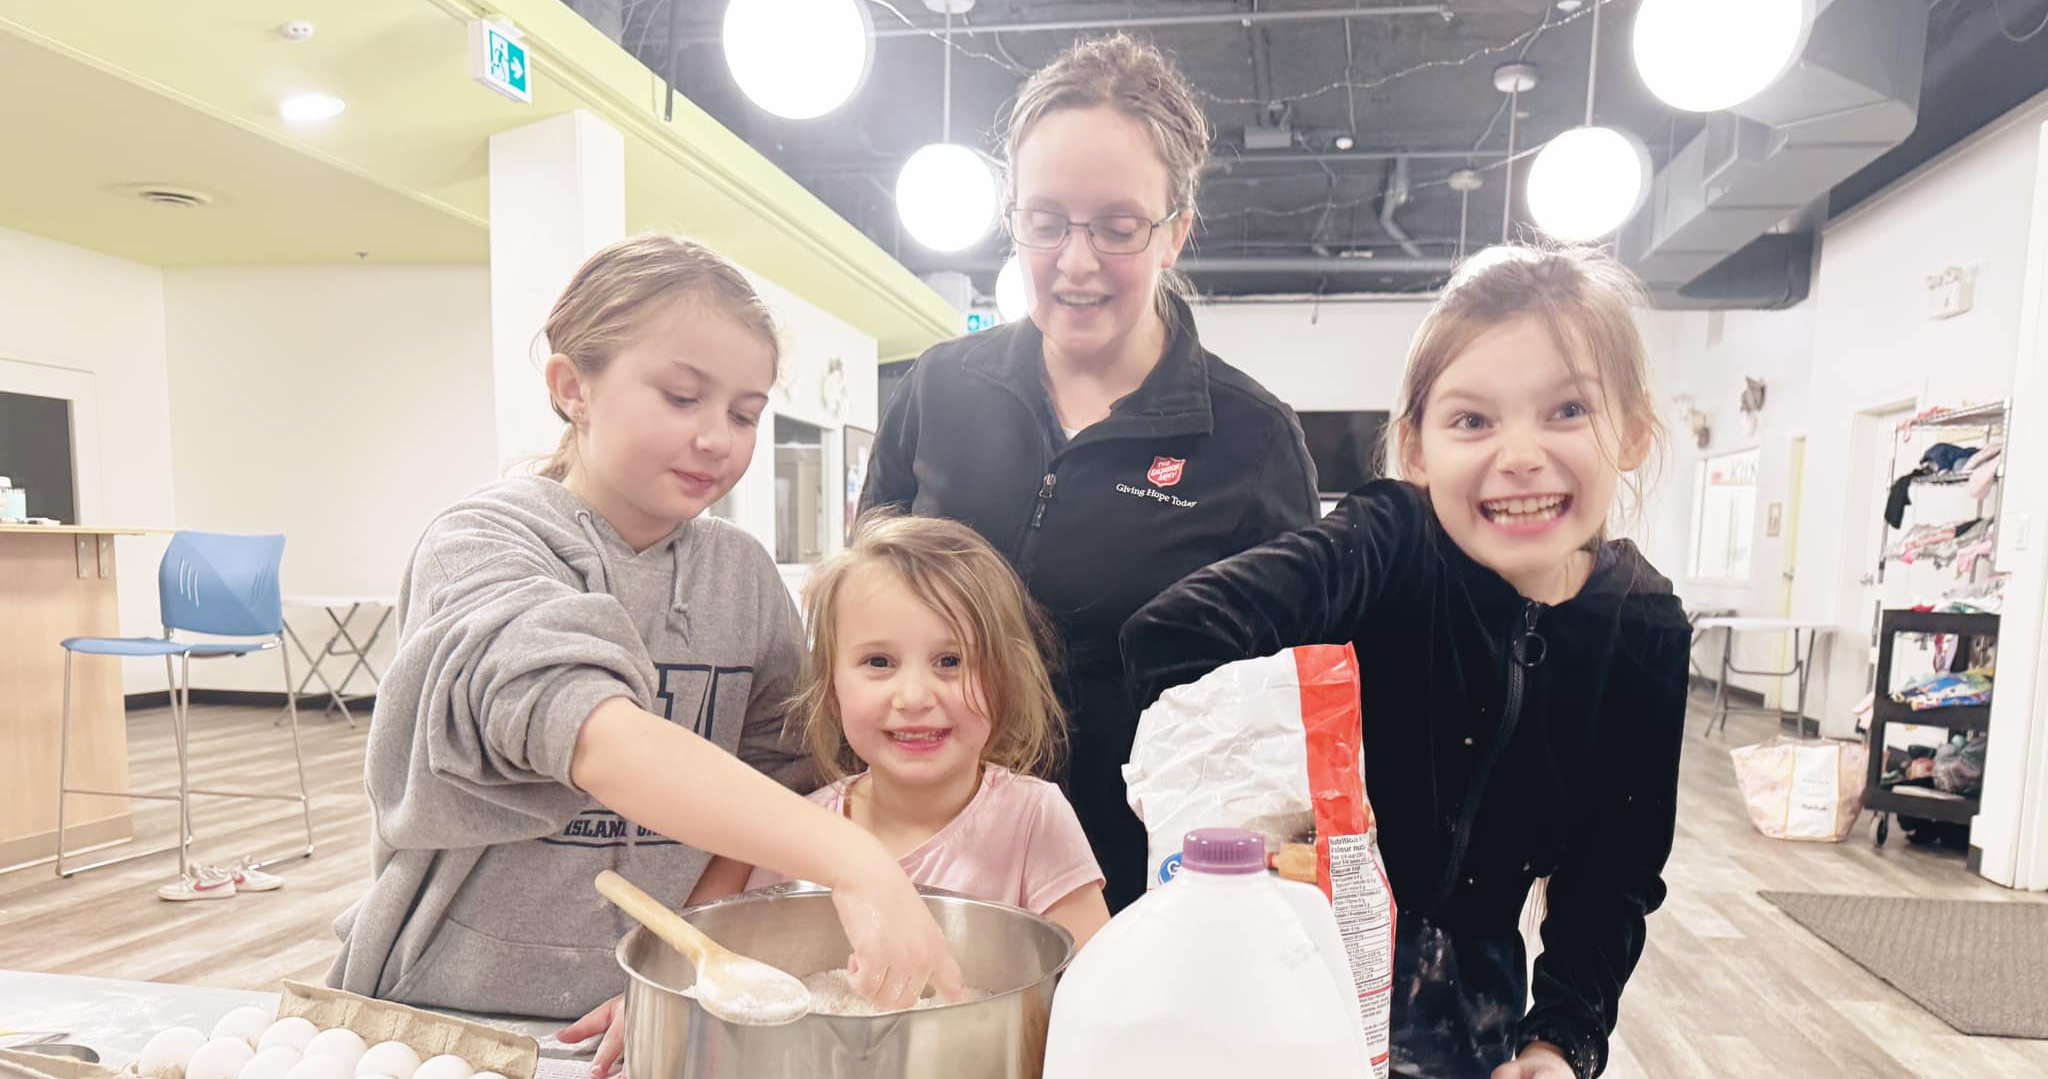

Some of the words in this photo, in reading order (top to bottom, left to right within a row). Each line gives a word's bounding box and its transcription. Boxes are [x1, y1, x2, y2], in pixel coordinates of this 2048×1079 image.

[1115, 483, 1146, 498] Giving
[1146, 488, 1170, 502] Hope
[1171, 495, 1198, 508] Today
